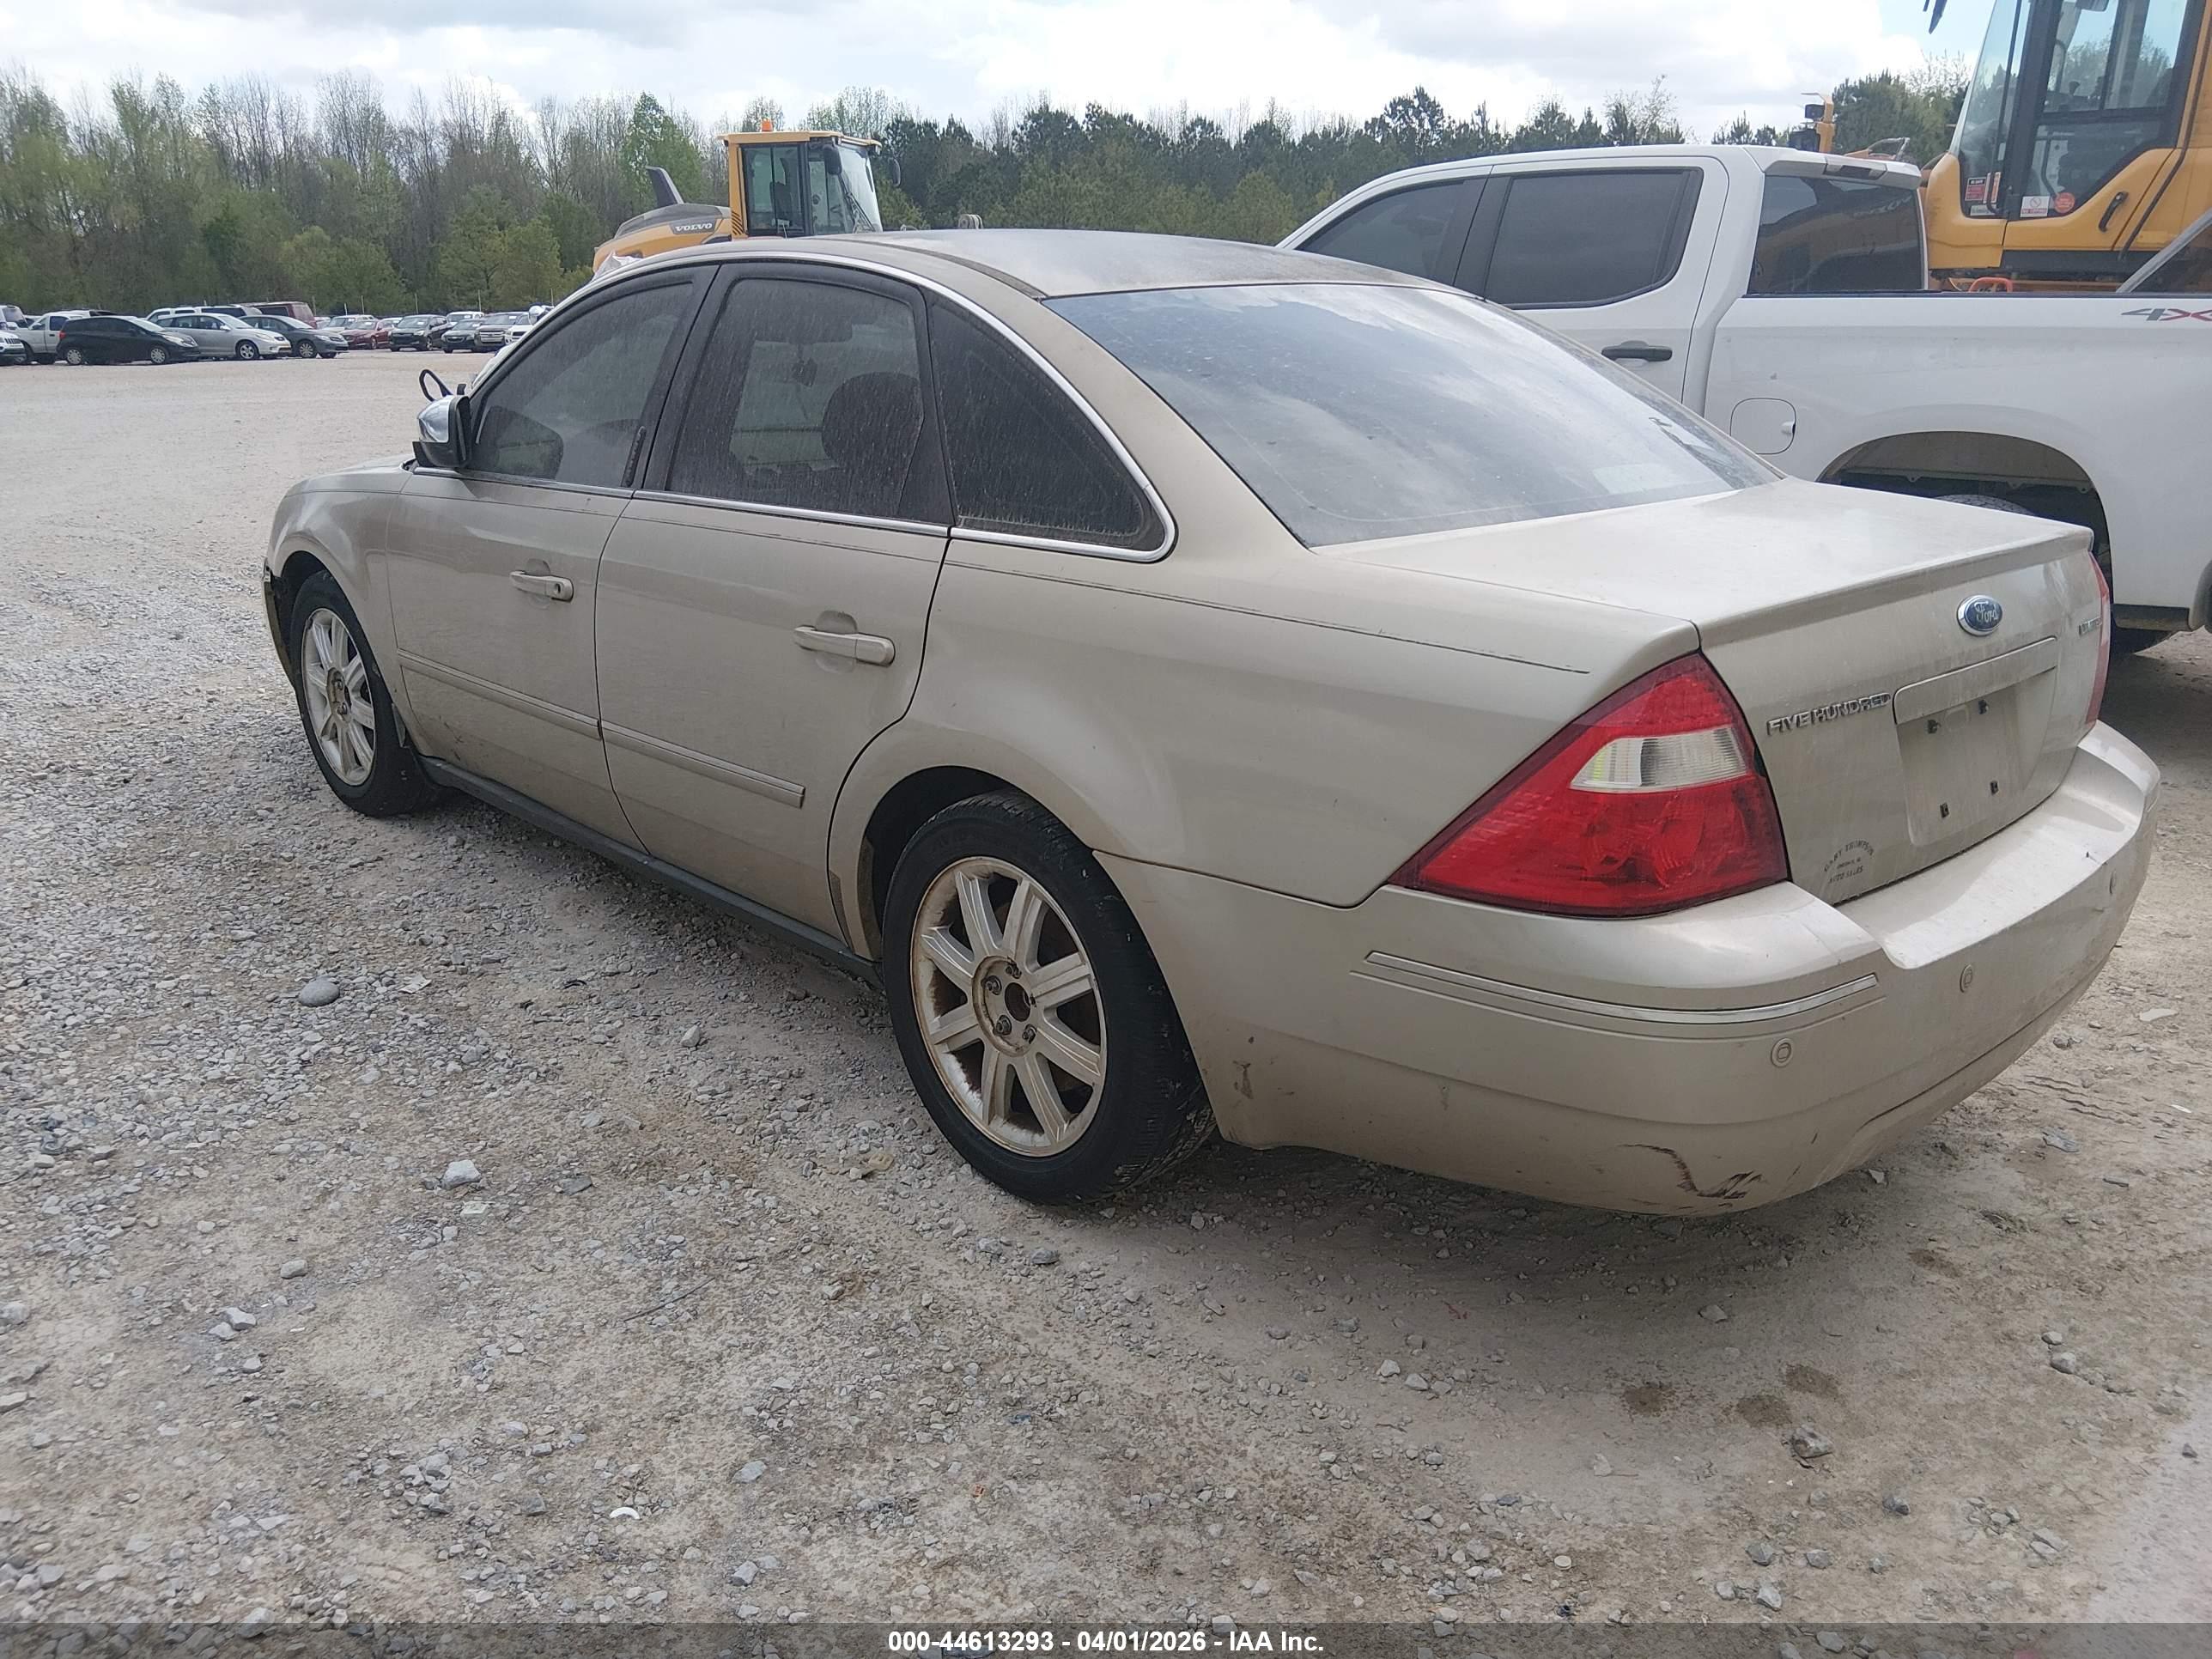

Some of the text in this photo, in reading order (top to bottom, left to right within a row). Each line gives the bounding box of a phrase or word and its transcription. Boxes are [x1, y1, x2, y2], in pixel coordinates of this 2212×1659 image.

[675, 222, 713, 232] VOLVO
[2120, 308, 2212, 321] 4X
[1974, 601, 1999, 625] Ford
[1767, 692, 1891, 736] FIVE HUNDRED
